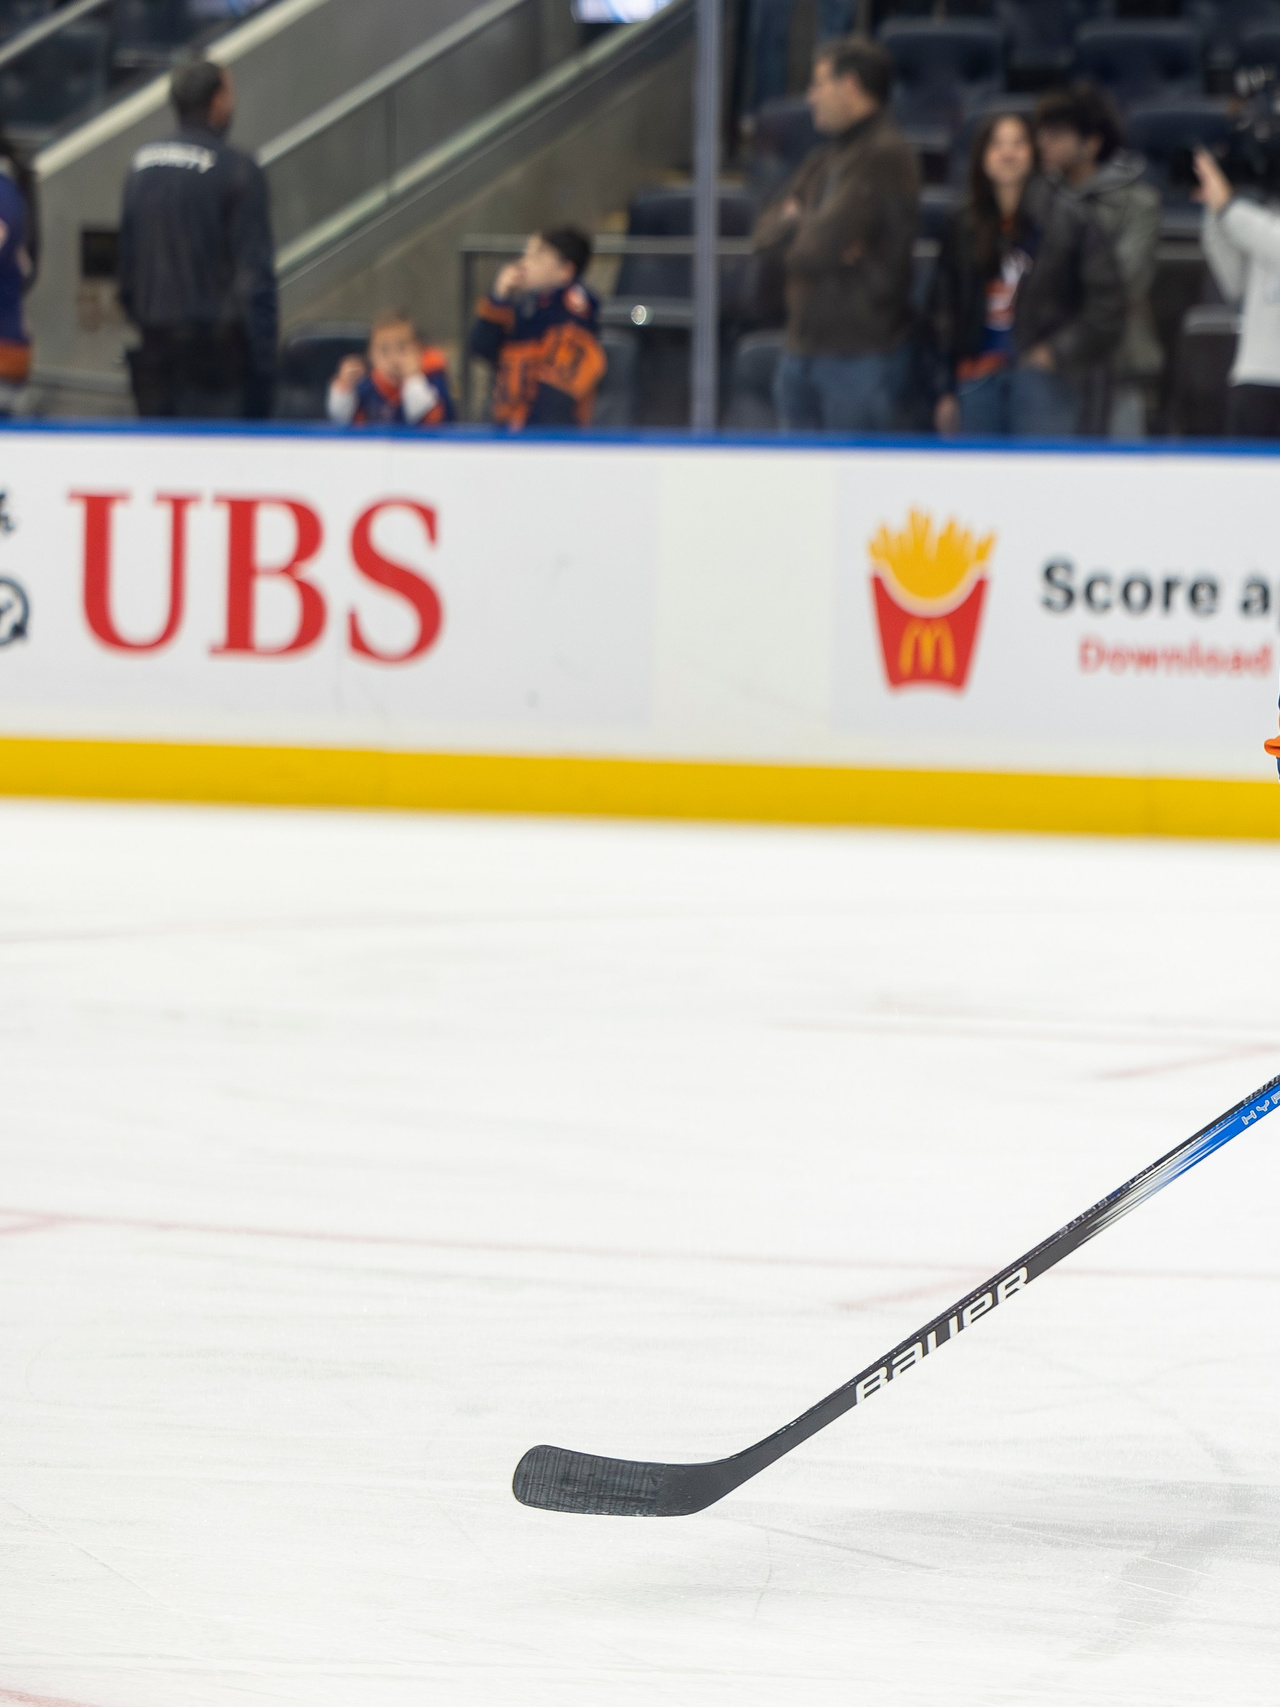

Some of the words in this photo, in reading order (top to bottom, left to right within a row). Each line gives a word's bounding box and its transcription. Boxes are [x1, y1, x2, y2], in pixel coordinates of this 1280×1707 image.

[67, 488, 446, 667] UBS
[1040, 556, 1221, 616] Score
[1077, 636, 1273, 676] Download
[856, 1266, 1029, 1405] BAUER
